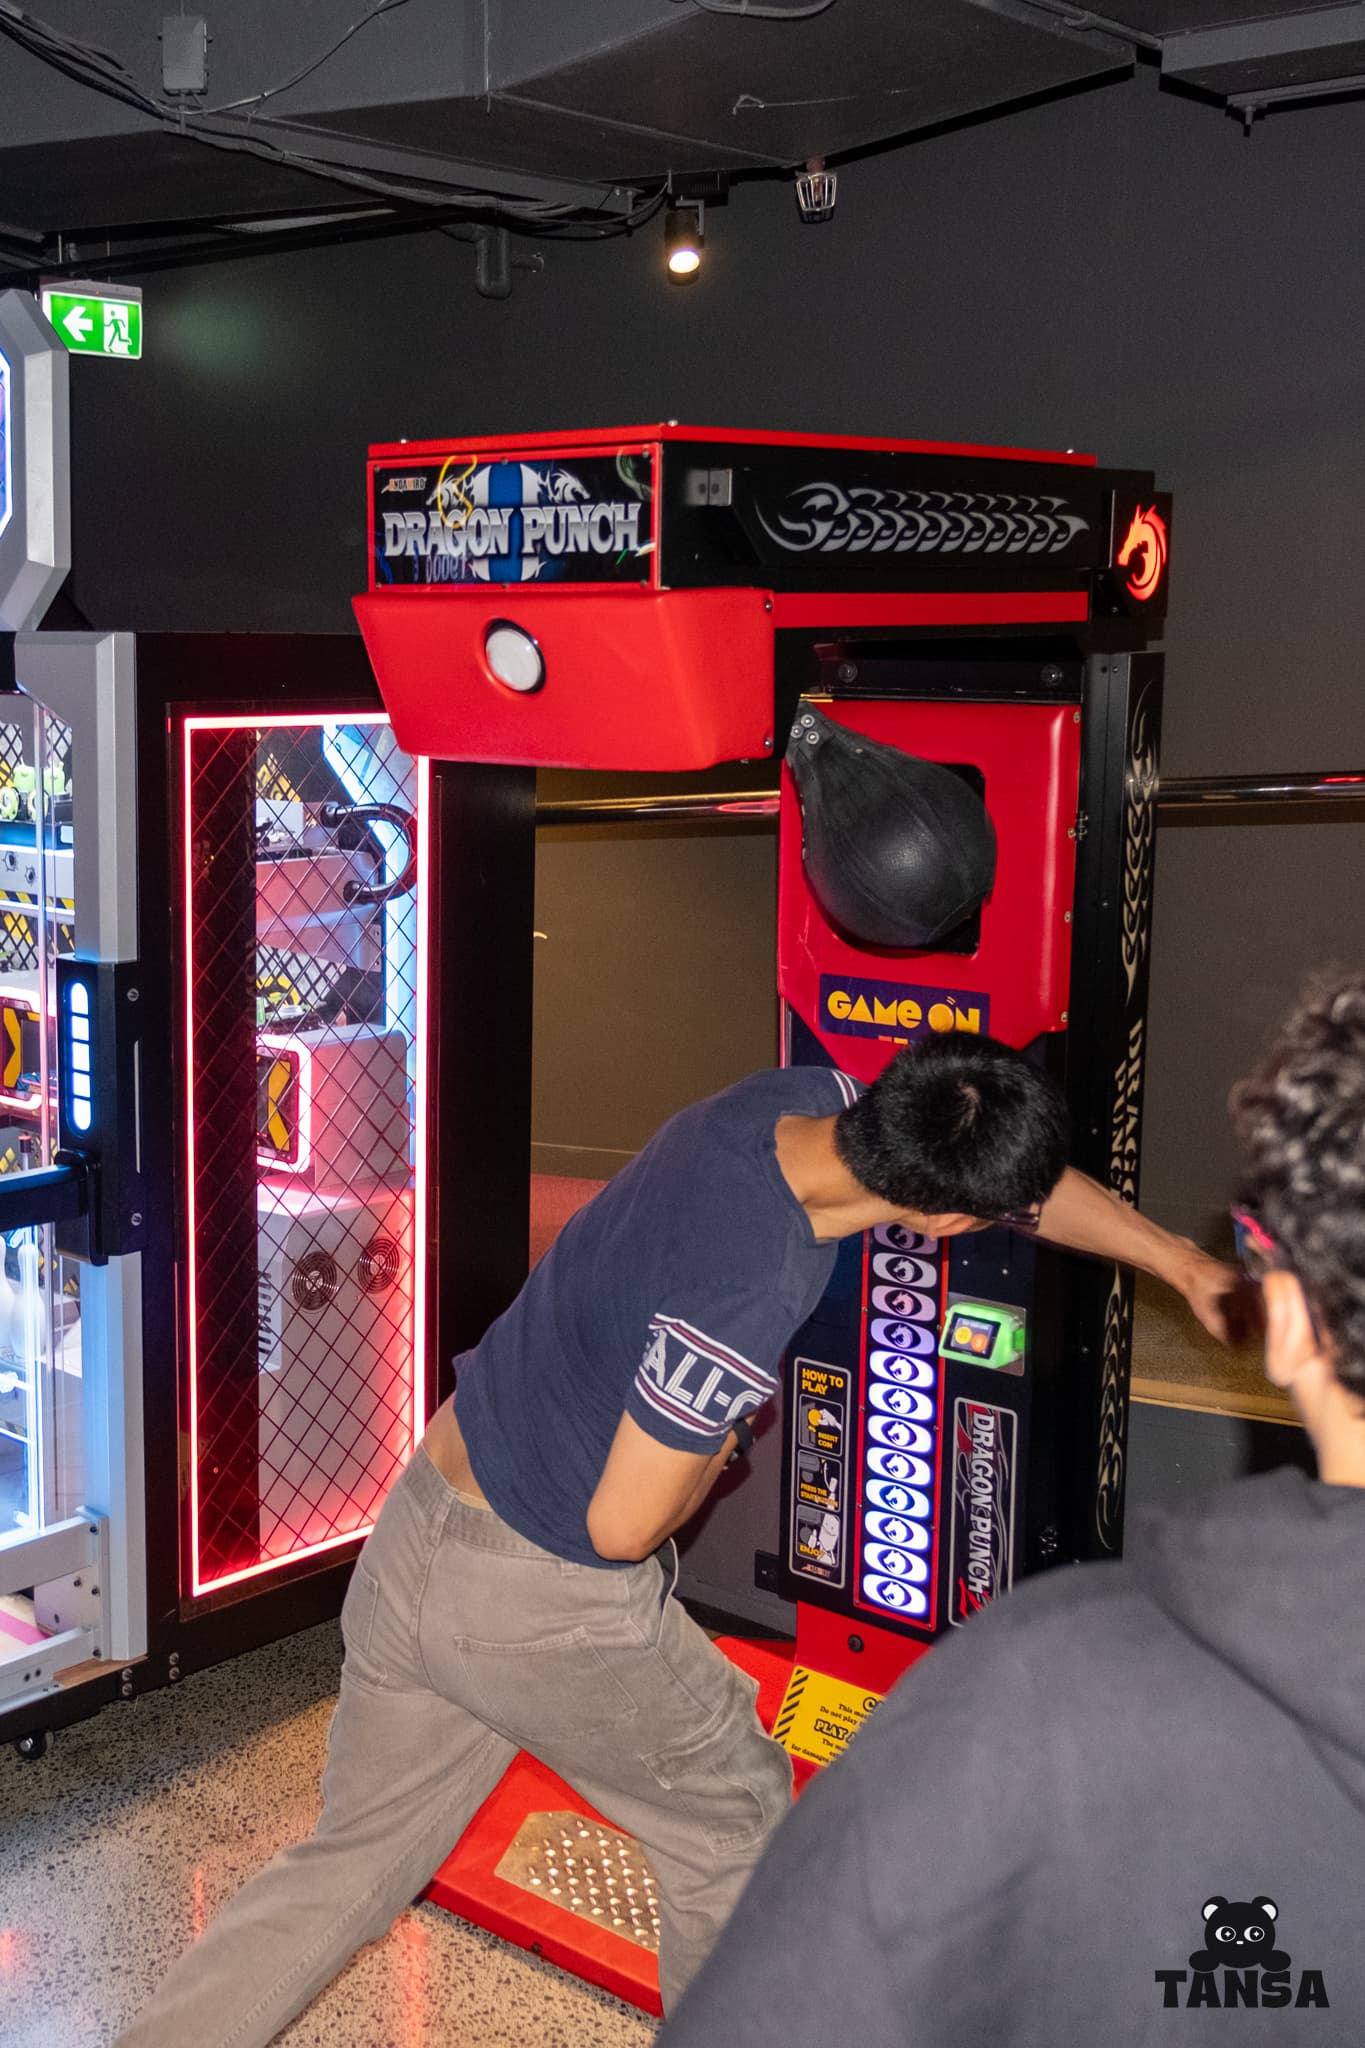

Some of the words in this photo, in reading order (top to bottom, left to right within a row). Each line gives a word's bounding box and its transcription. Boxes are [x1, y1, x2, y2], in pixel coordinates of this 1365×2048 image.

[382, 508, 514, 557] DRAGON
[519, 501, 643, 554] PUNCH
[827, 990, 922, 1029] GAME
[927, 1000, 981, 1034] ON
[1110, 1060, 1127, 1190] PUNC
[1120, 1017, 1143, 1206] DRAGO
[802, 1368, 827, 1384] HOW
[829, 1375, 844, 1388] TO
[802, 1380, 828, 1395] PLAY
[971, 1411, 994, 1512] DRAGON
[968, 1513, 992, 1594] PUNCH
[814, 1718, 848, 1740] PLAY
